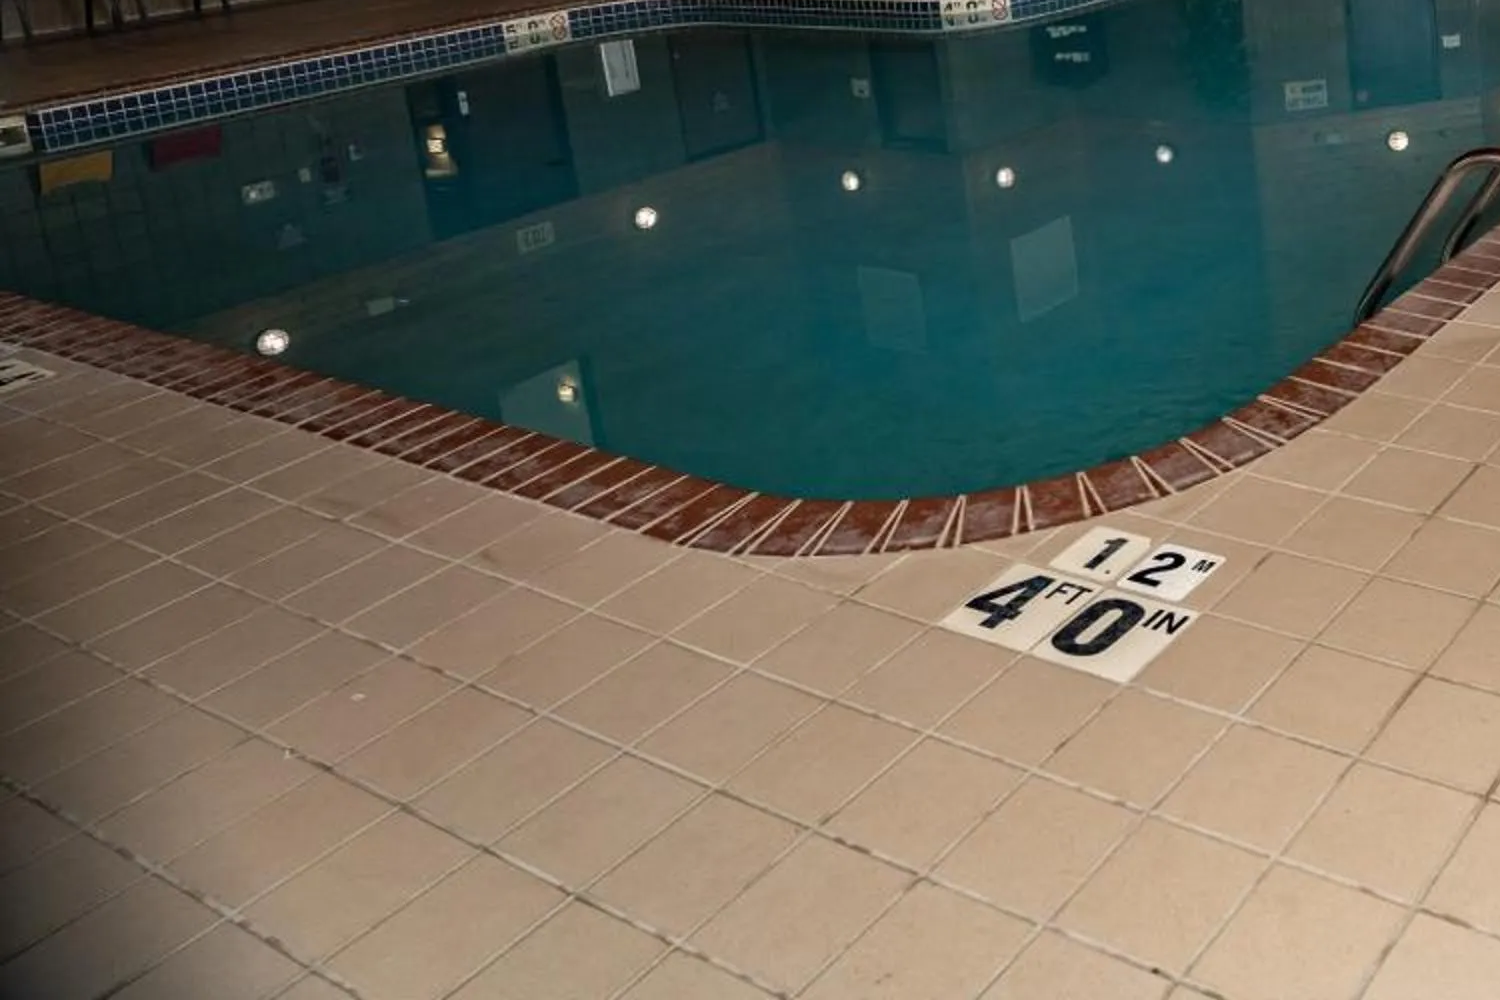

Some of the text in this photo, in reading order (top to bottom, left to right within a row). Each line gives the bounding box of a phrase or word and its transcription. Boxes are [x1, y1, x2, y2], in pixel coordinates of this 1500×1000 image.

[965, 575, 1190, 656] 4 FT 0 IN
